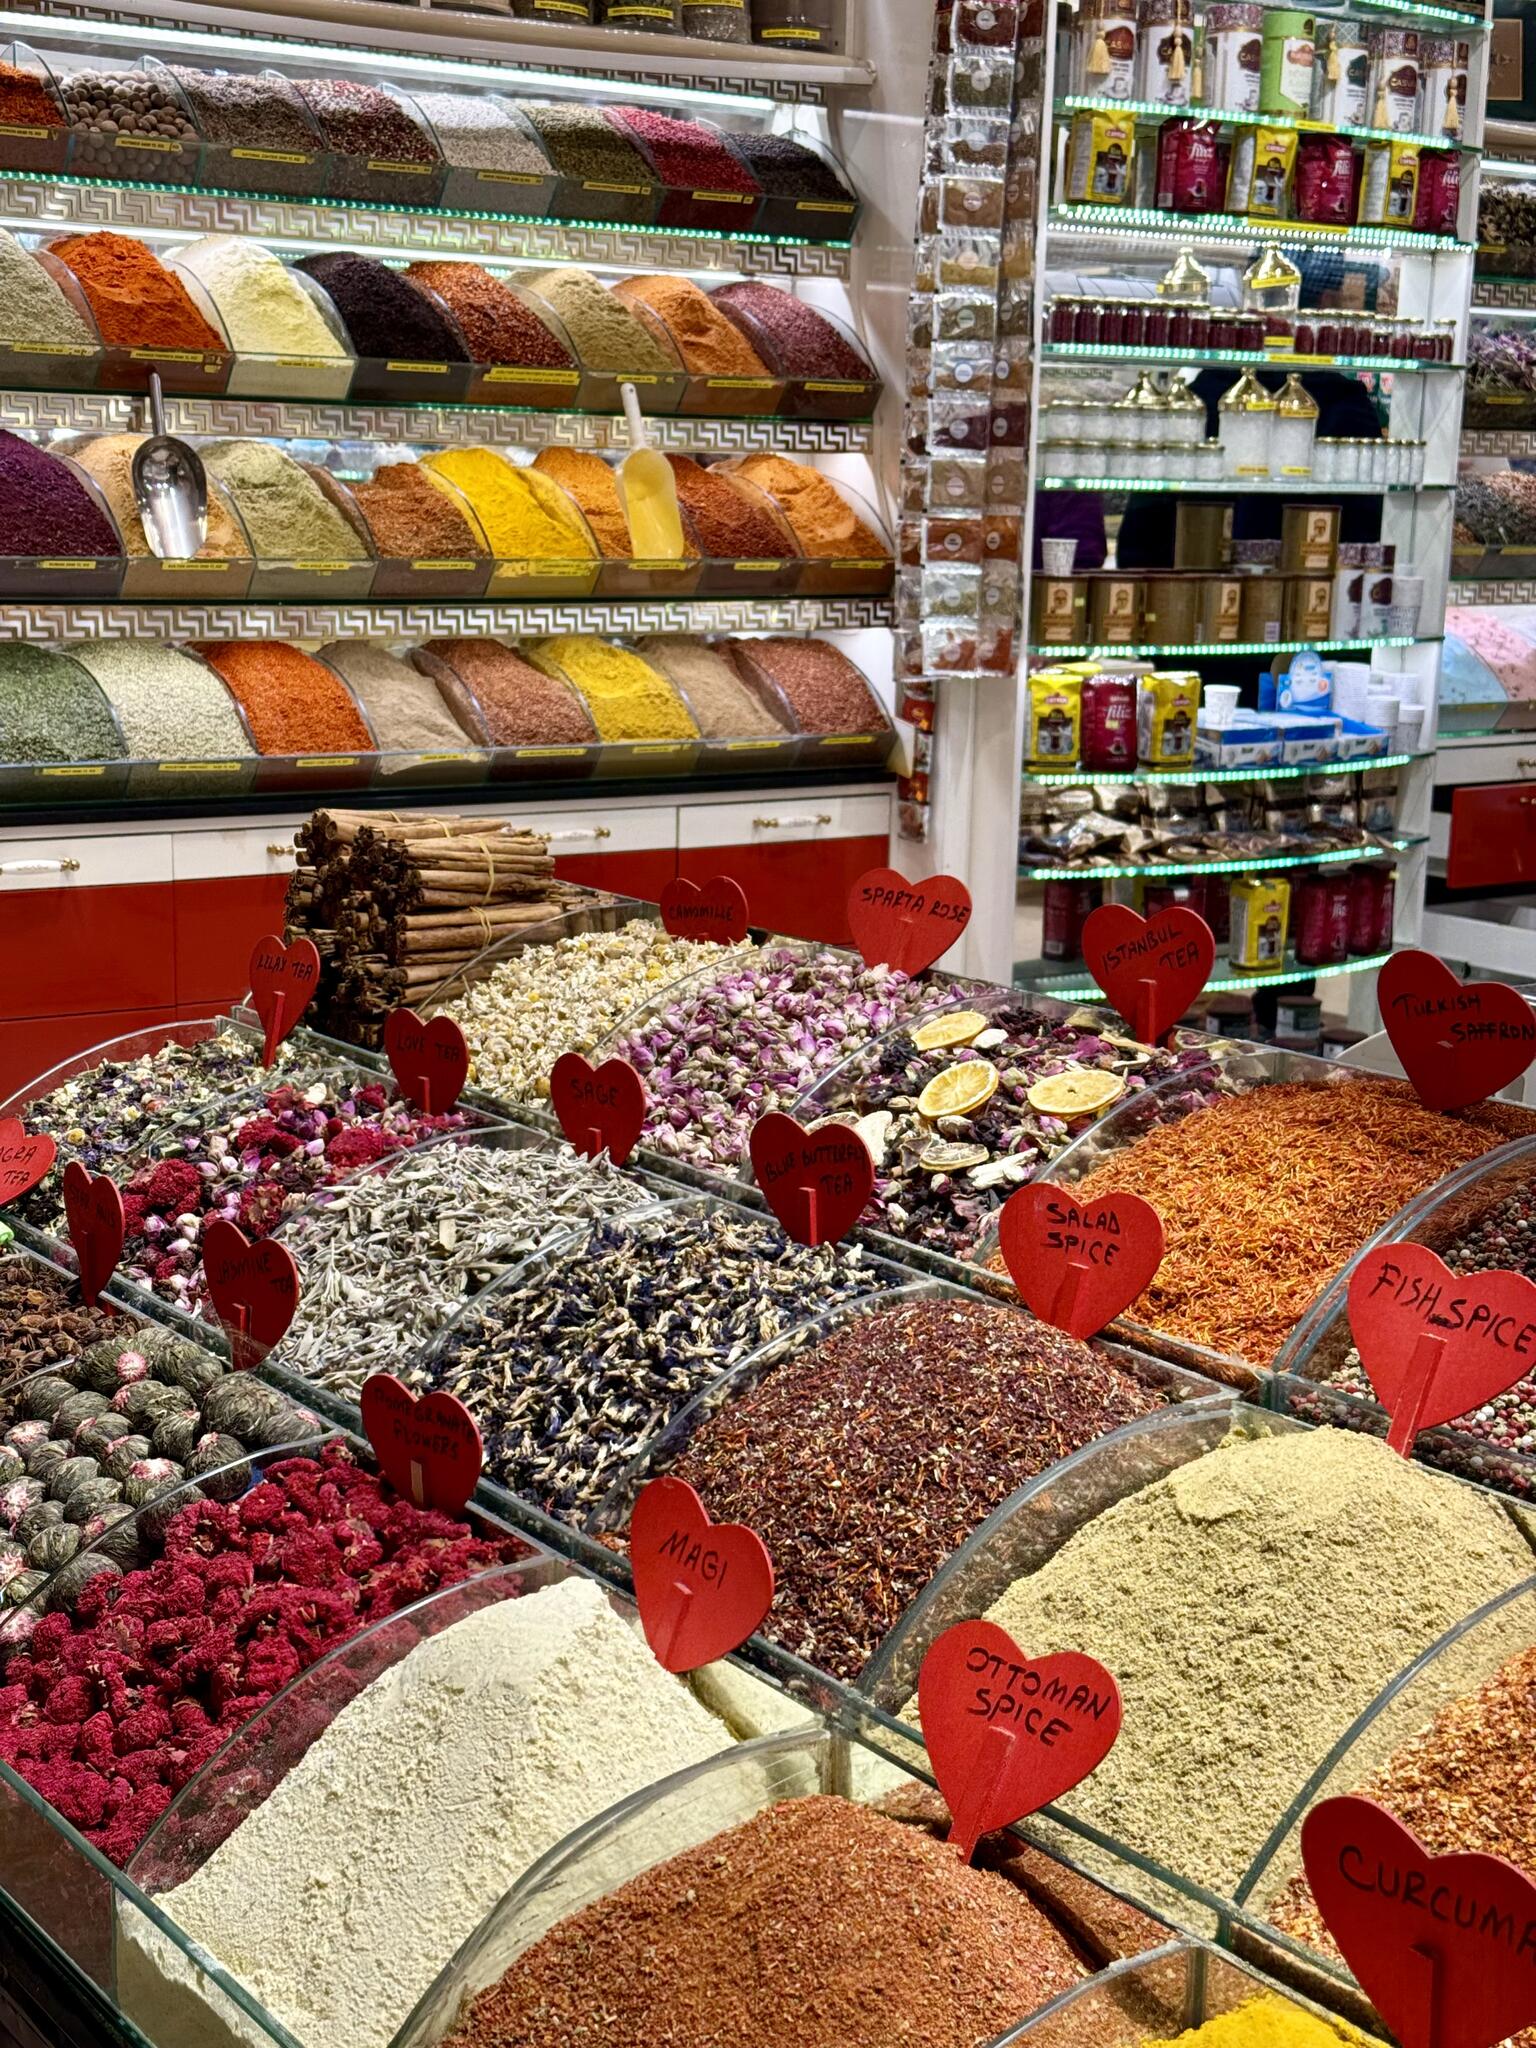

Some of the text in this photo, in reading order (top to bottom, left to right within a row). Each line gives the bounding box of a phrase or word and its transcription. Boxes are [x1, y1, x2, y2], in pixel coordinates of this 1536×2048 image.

[862, 886, 971, 924] SPARTA ROSE
[1102, 923, 1182, 976] ISTANBUL
[1158, 940, 1200, 971] TEA
[291, 961, 314, 981] TEA
[1391, 992, 1481, 1019] TURKISH
[397, 1031, 460, 1062] LOVE TEA
[1451, 1021, 1536, 1043] SAFFRON
[570, 1078, 620, 1108] SAGE
[4, 1170, 31, 1186] TEA
[763, 1151, 796, 1184] BLUE
[819, 1171, 853, 1197] TEA
[1045, 1203, 1121, 1235] SALAD
[1040, 1231, 1120, 1267] SPICE
[1367, 1261, 1536, 1354] FISH SPICE
[393, 1417, 459, 1461] FLOWERS
[658, 1529, 728, 1590] MAGI
[966, 1646, 1111, 1722] OTTOMAN
[967, 1688, 1074, 1747] SPICE
